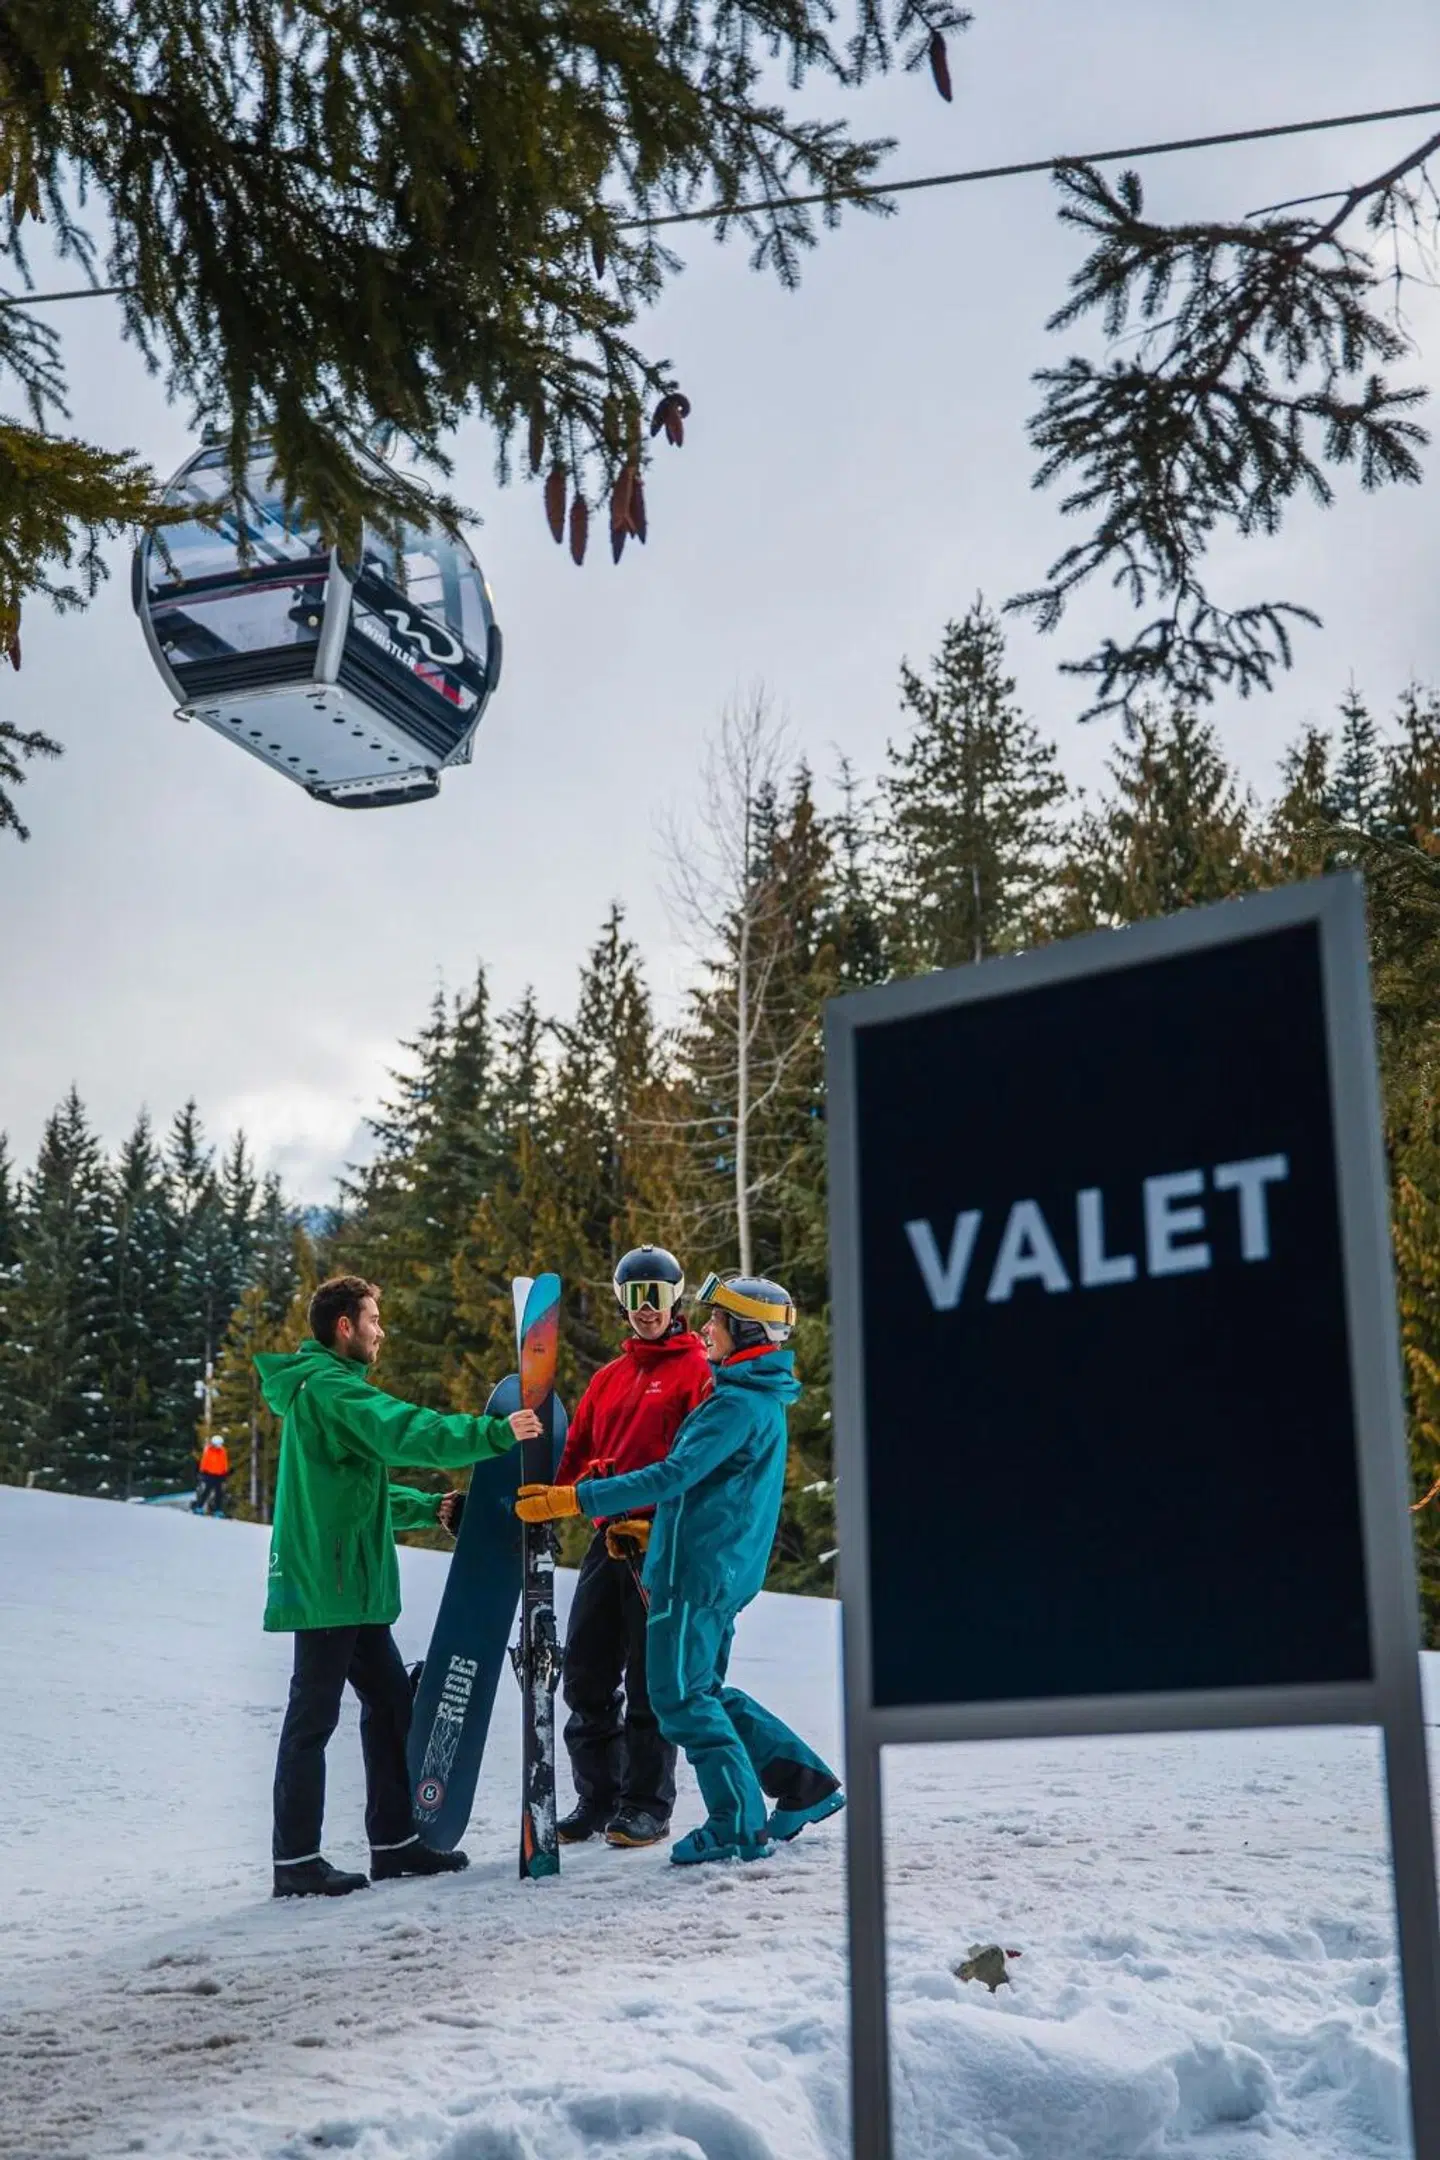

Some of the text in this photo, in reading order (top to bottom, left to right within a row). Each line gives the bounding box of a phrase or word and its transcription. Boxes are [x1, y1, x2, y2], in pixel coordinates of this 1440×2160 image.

[362, 619, 418, 670] WHISTLER
[904, 1152, 1290, 1312] VALET
[437, 1655, 478, 1724] RIDE
